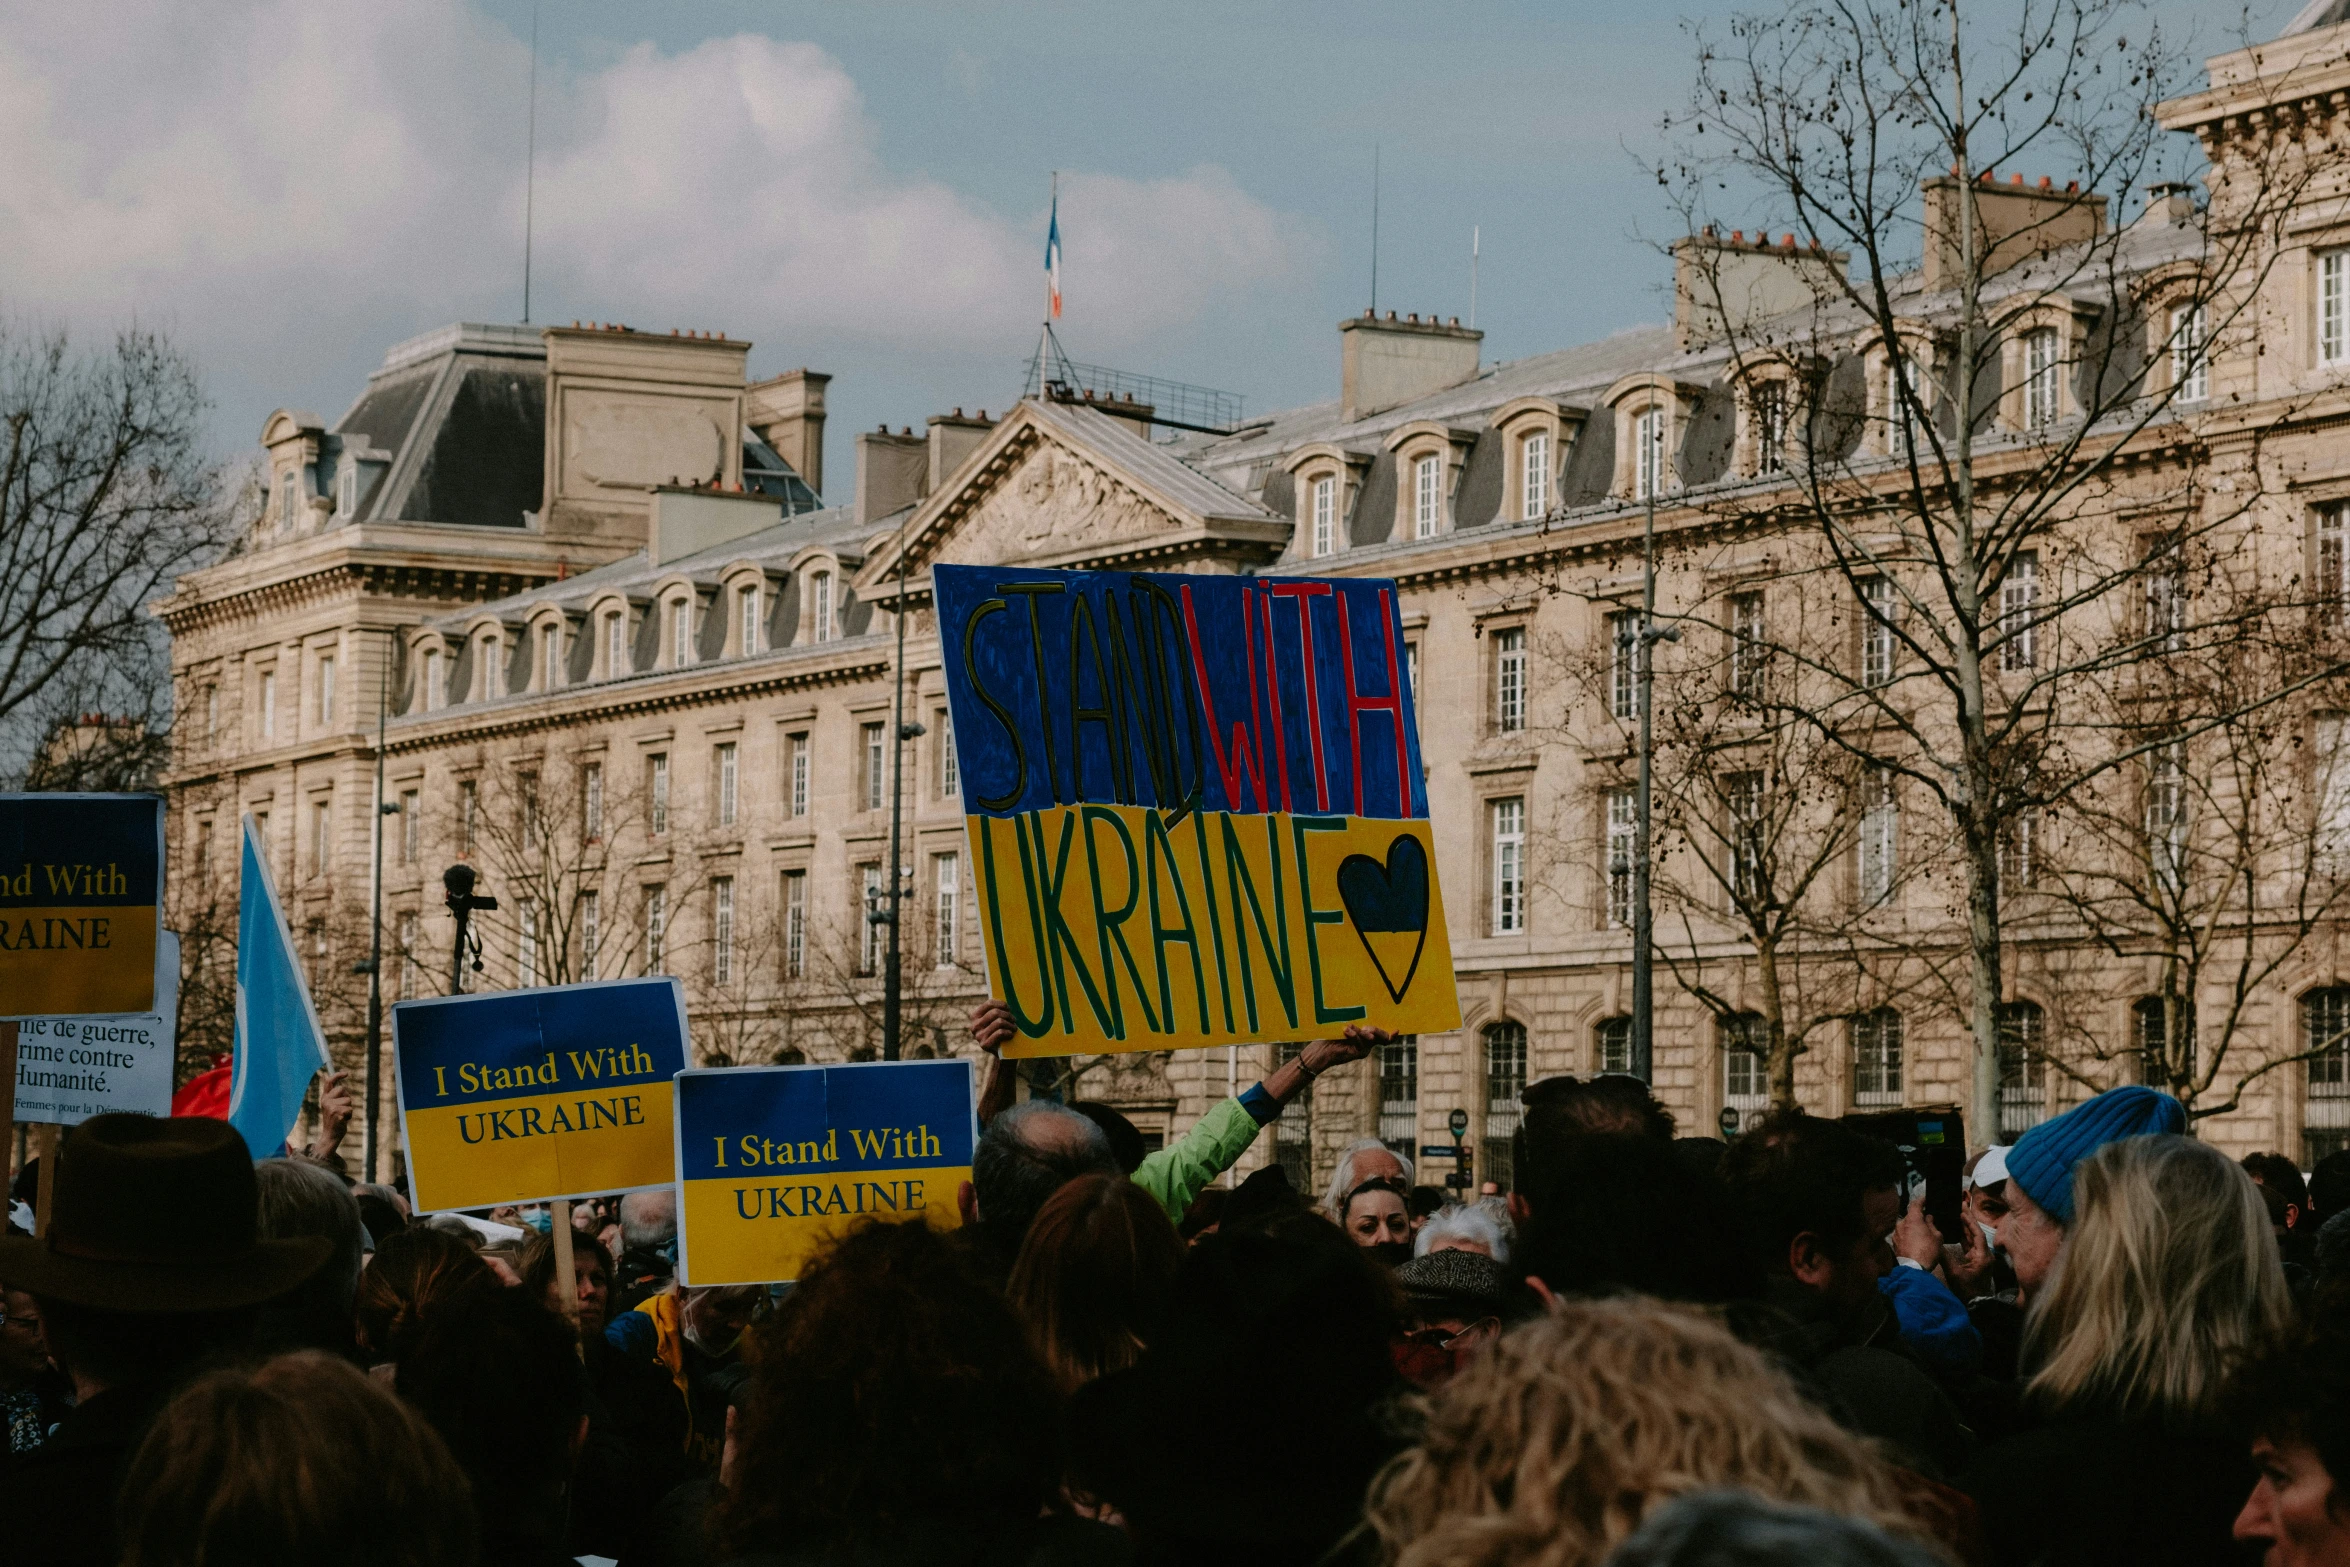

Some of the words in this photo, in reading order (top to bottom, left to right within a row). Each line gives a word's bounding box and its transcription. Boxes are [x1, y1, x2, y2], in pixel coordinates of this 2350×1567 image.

[965, 576, 1202, 828] STAND
[43, 862, 128, 896] With
[981, 804, 1367, 1040] UKRAINE
[81, 1024, 155, 1049] guerre,
[69, 1048, 134, 1069] contre
[433, 1066, 449, 1096] I
[459, 1052, 560, 1094] Stand
[566, 1043, 655, 1081] With
[15, 1097, 56, 1111] Femmes
[58, 1102, 81, 1114] pour
[83, 1103, 92, 1114] la
[456, 1095, 645, 1145] UKRAINE
[713, 1136, 728, 1168] I
[740, 1129, 840, 1167] Stand
[848, 1124, 943, 1161] With
[734, 1180, 927, 1220] UKRAINE
